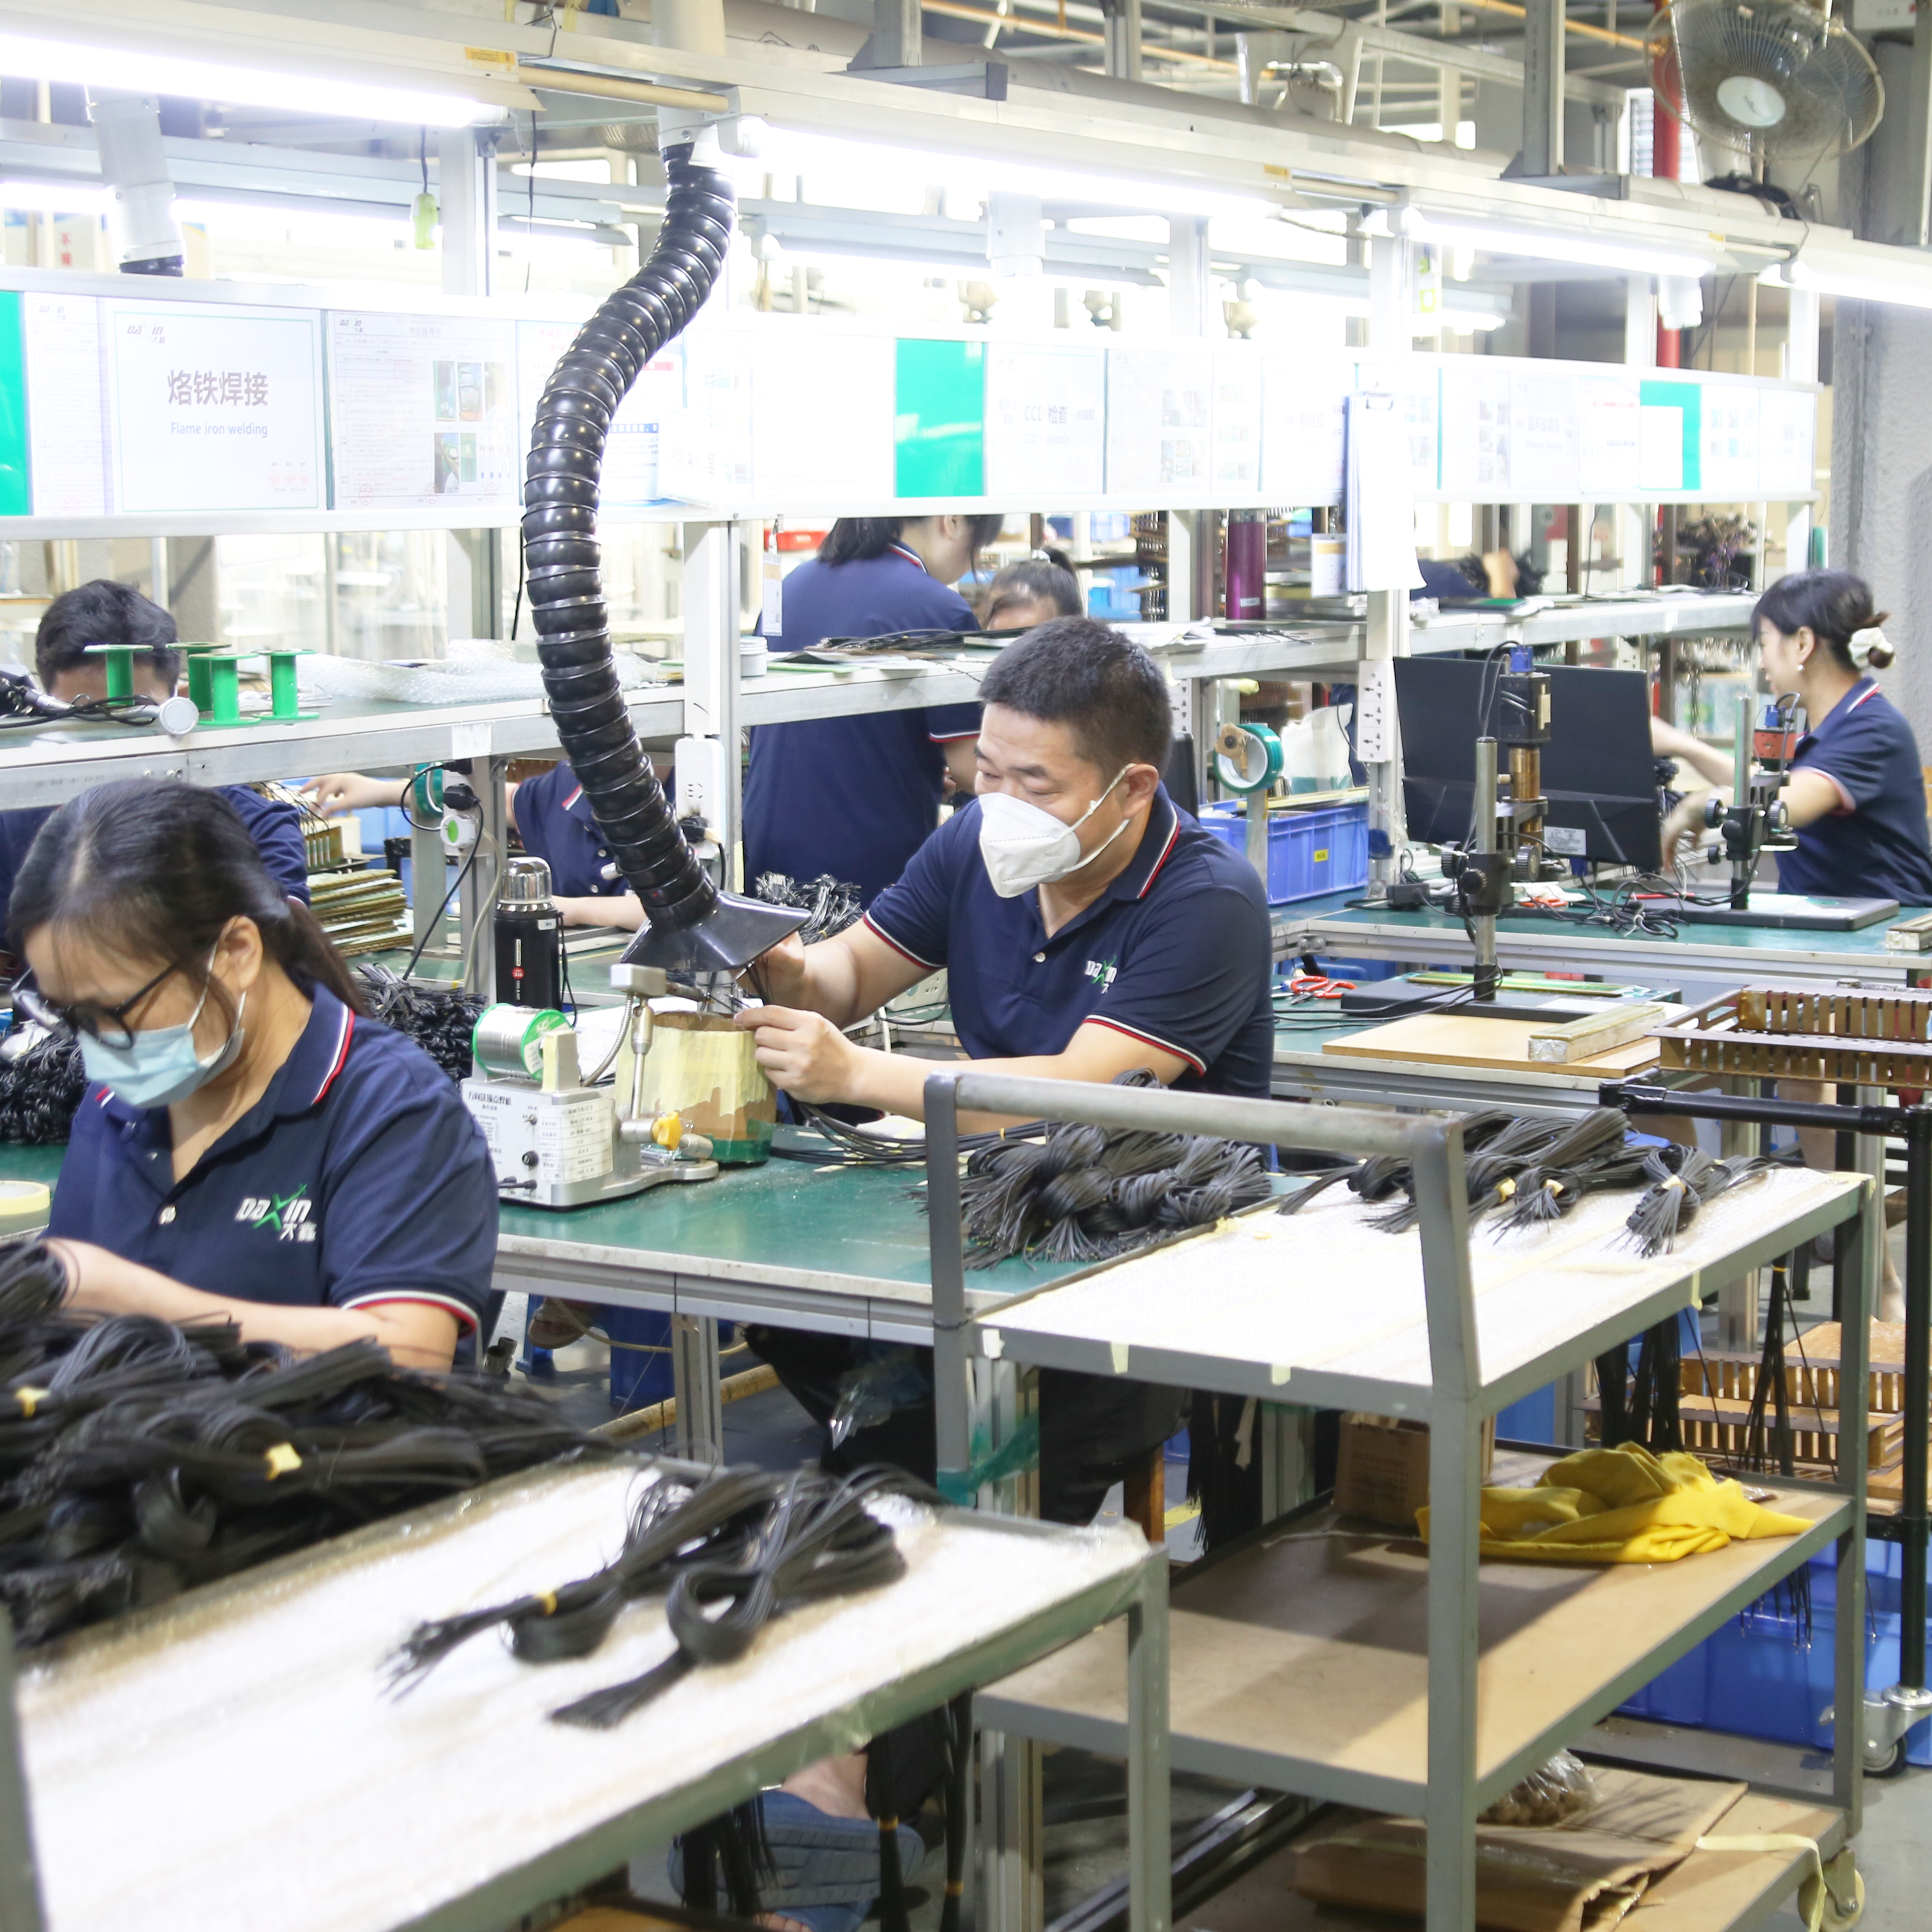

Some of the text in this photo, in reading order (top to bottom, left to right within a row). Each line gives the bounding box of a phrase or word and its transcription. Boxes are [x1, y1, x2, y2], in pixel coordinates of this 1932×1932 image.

[168, 369, 269, 407] 烙铁焊接
[1024, 405, 1069, 425] CCD 检查
[1076, 409, 1095, 421] 包硅胶
[1300, 411, 1324, 429] 包硅胶
[1528, 415, 1561, 433] 超声波清洗
[1564, 414, 1574, 423] CCD
[171, 422, 268, 439] Flame iron welding
[1023, 433, 1038, 444] CCD
[670, 443, 717, 480] 待补焊
[234, 1184, 313, 1231] DaXin
